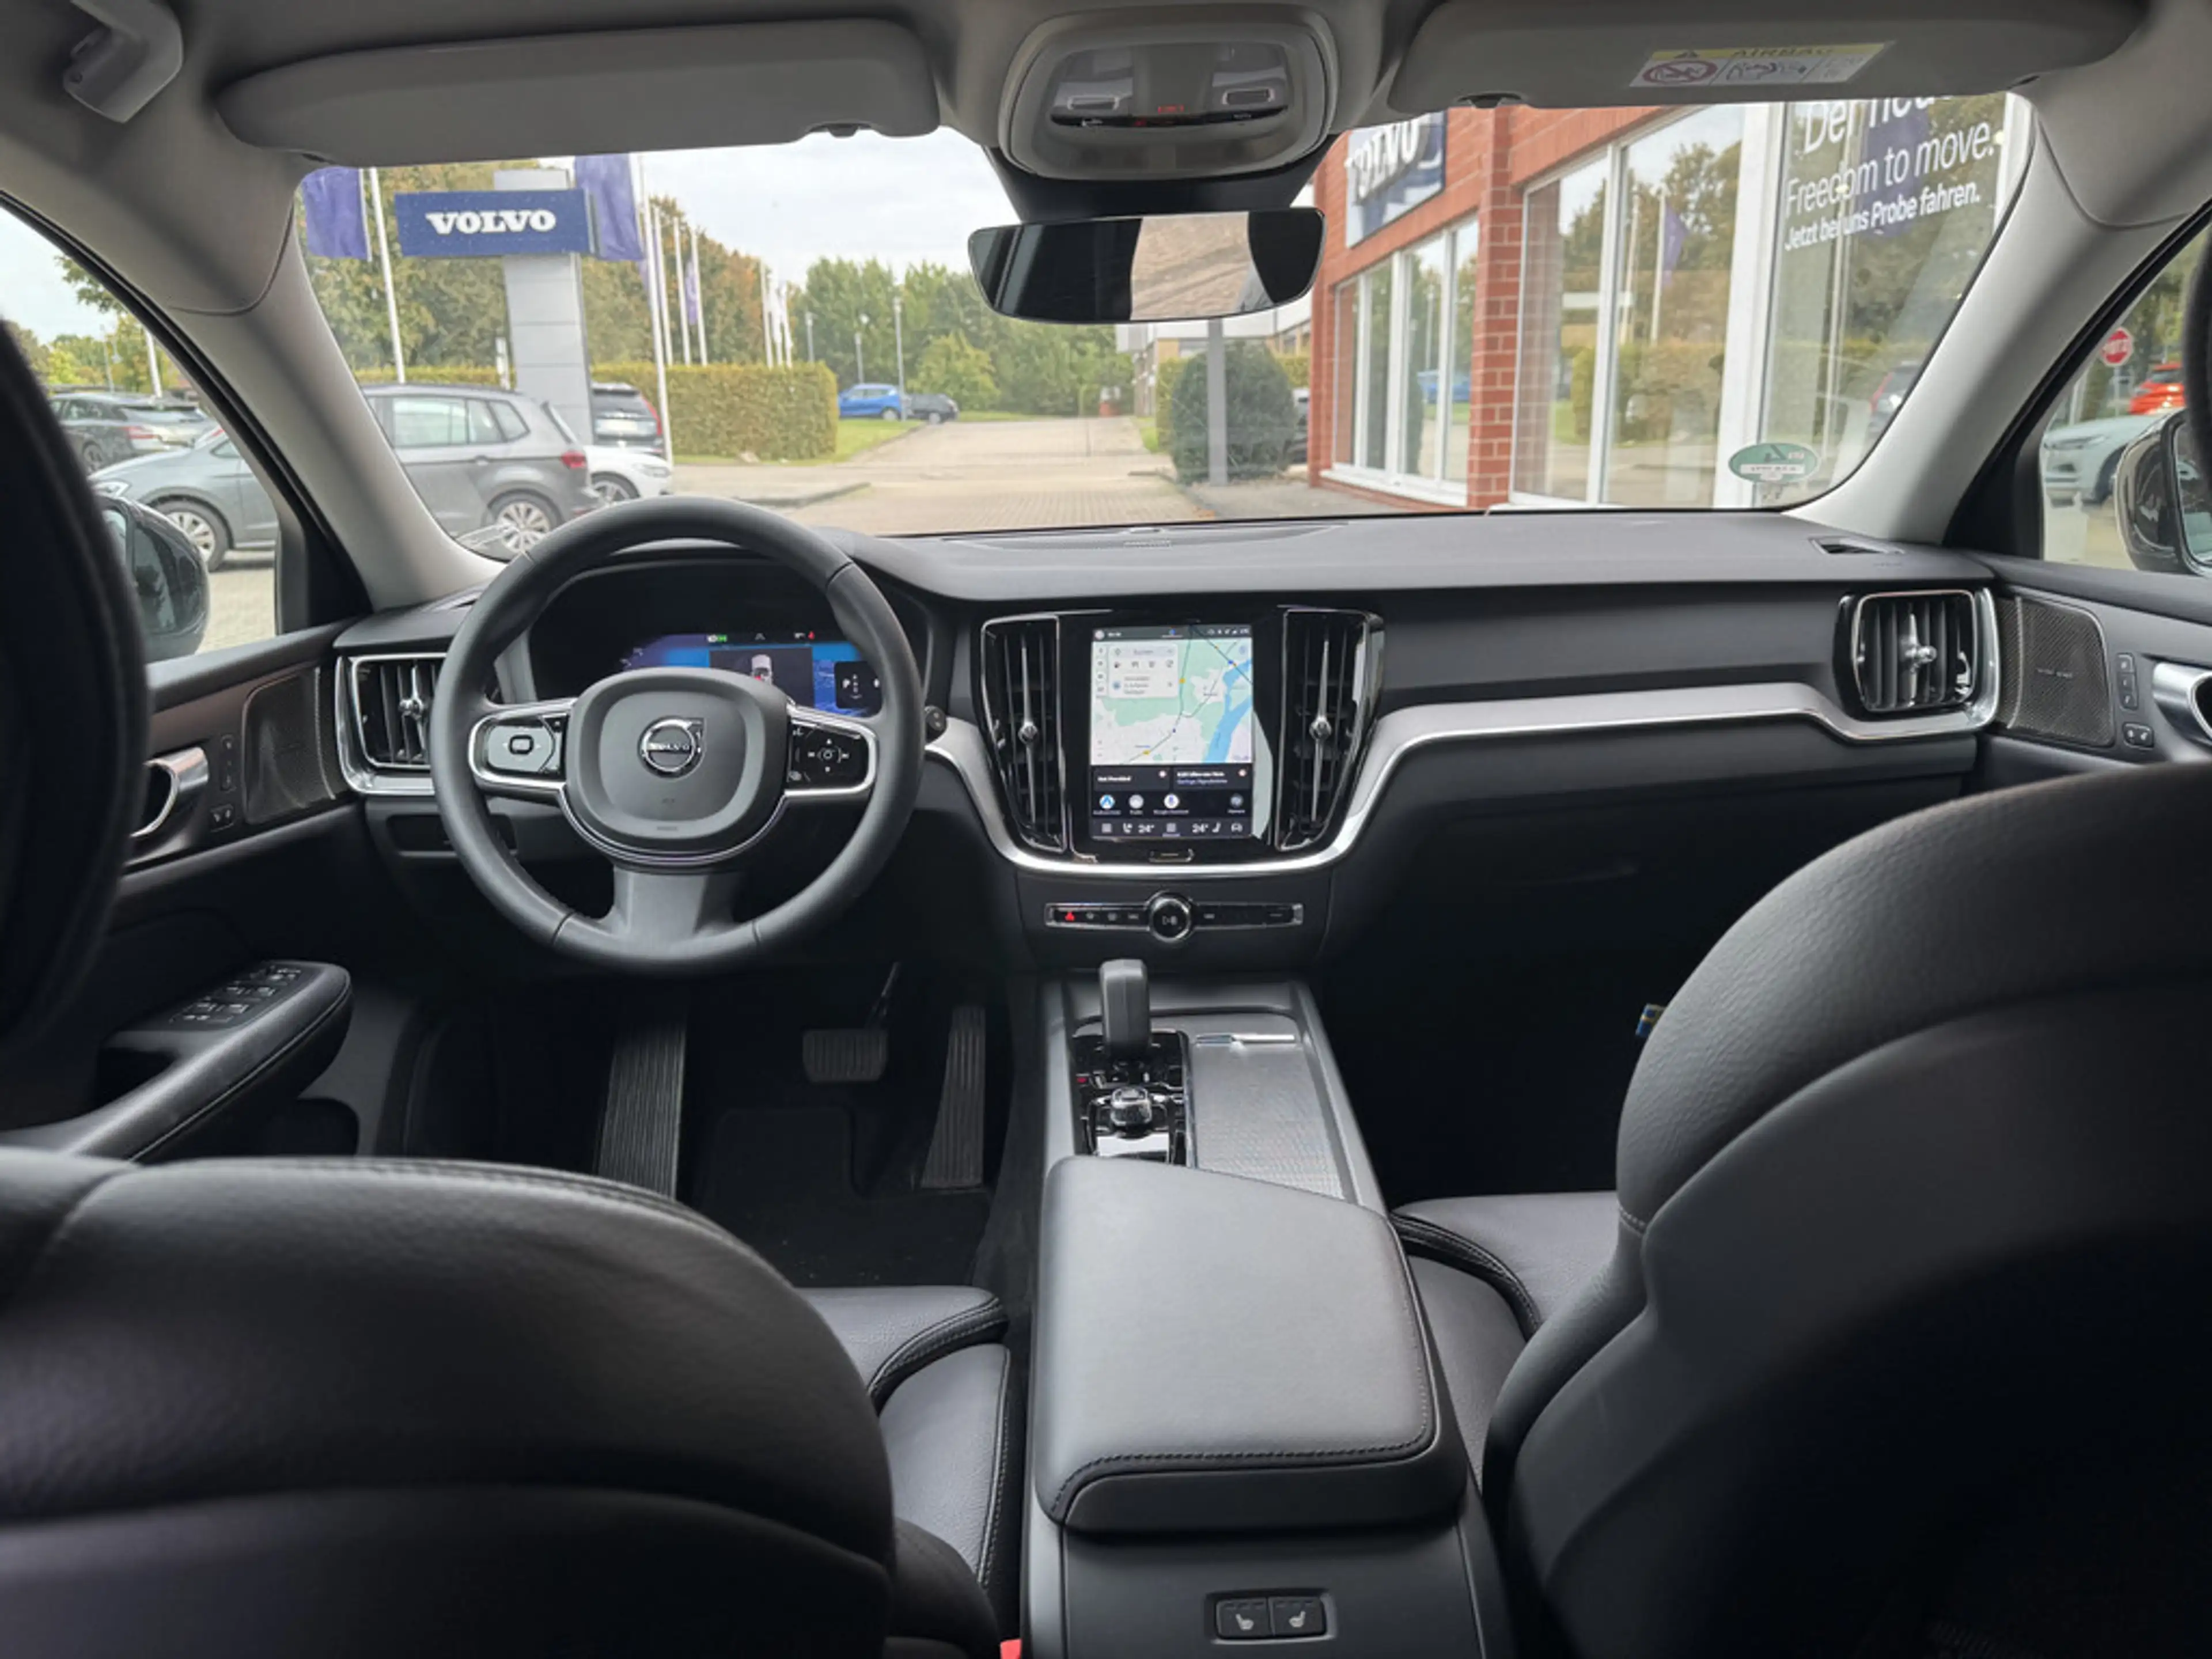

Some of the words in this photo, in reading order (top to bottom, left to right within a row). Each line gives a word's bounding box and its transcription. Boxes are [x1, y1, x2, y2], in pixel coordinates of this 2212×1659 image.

[1786, 161, 1878, 218] Freedom
[1884, 146, 1910, 187] to
[1914, 122, 1995, 177] move.
[425, 209, 556, 235] VOLVO
[1785, 221, 1818, 251] Jetzt
[1820, 215, 1842, 242] bei
[1843, 210, 1870, 235] uns
[1870, 194, 1918, 228] Probe
[1918, 181, 1982, 216] fahren.
